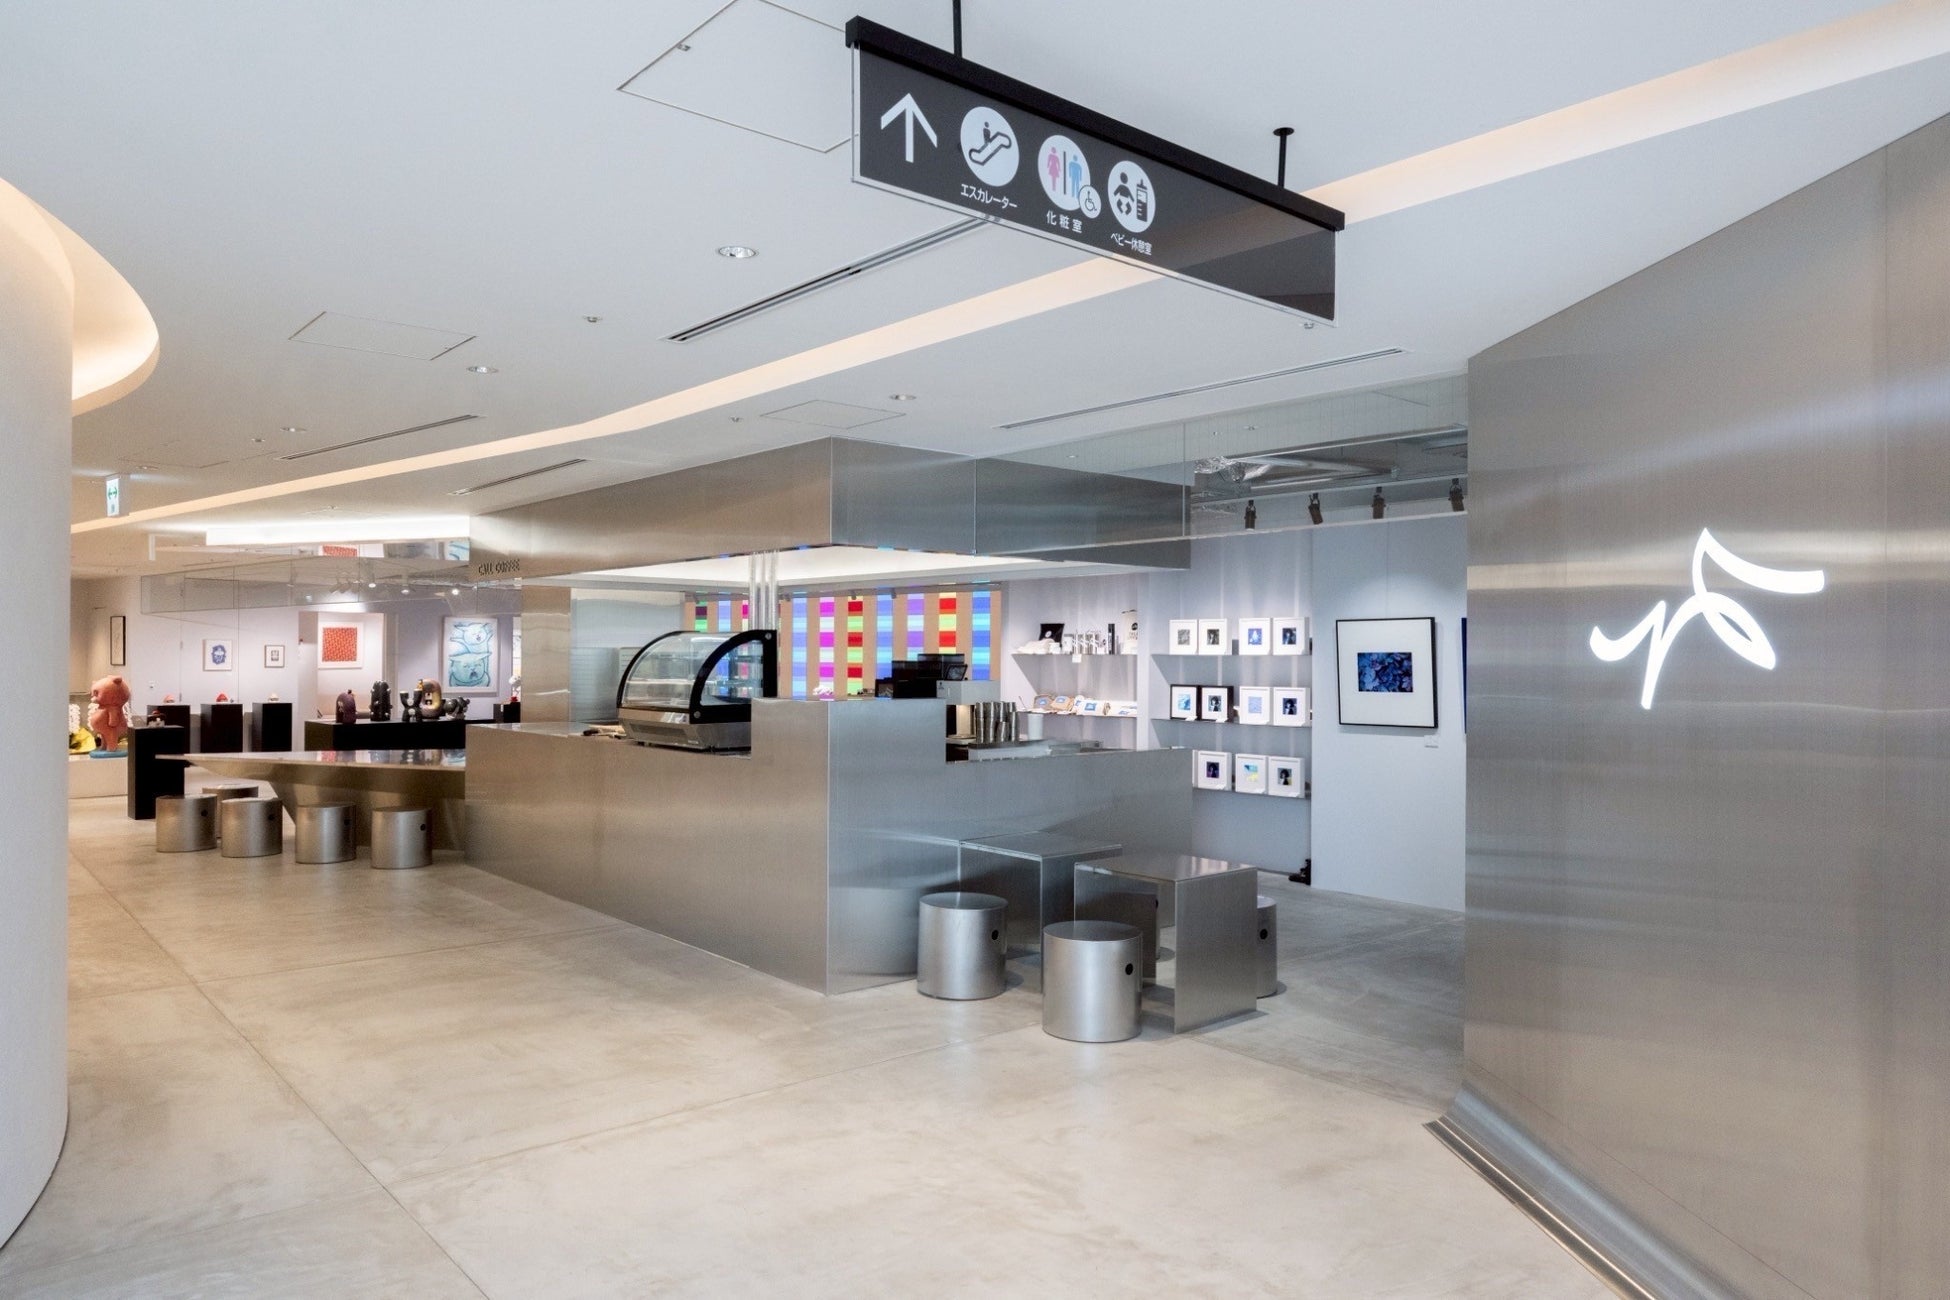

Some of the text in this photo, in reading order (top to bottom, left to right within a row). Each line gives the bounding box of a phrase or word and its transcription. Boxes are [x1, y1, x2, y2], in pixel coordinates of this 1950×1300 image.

[960, 183, 1018, 209] エスカレーター
[1046, 210, 1083, 234] 化粧室
[1110, 232, 1152, 256] ベビー休憩室
